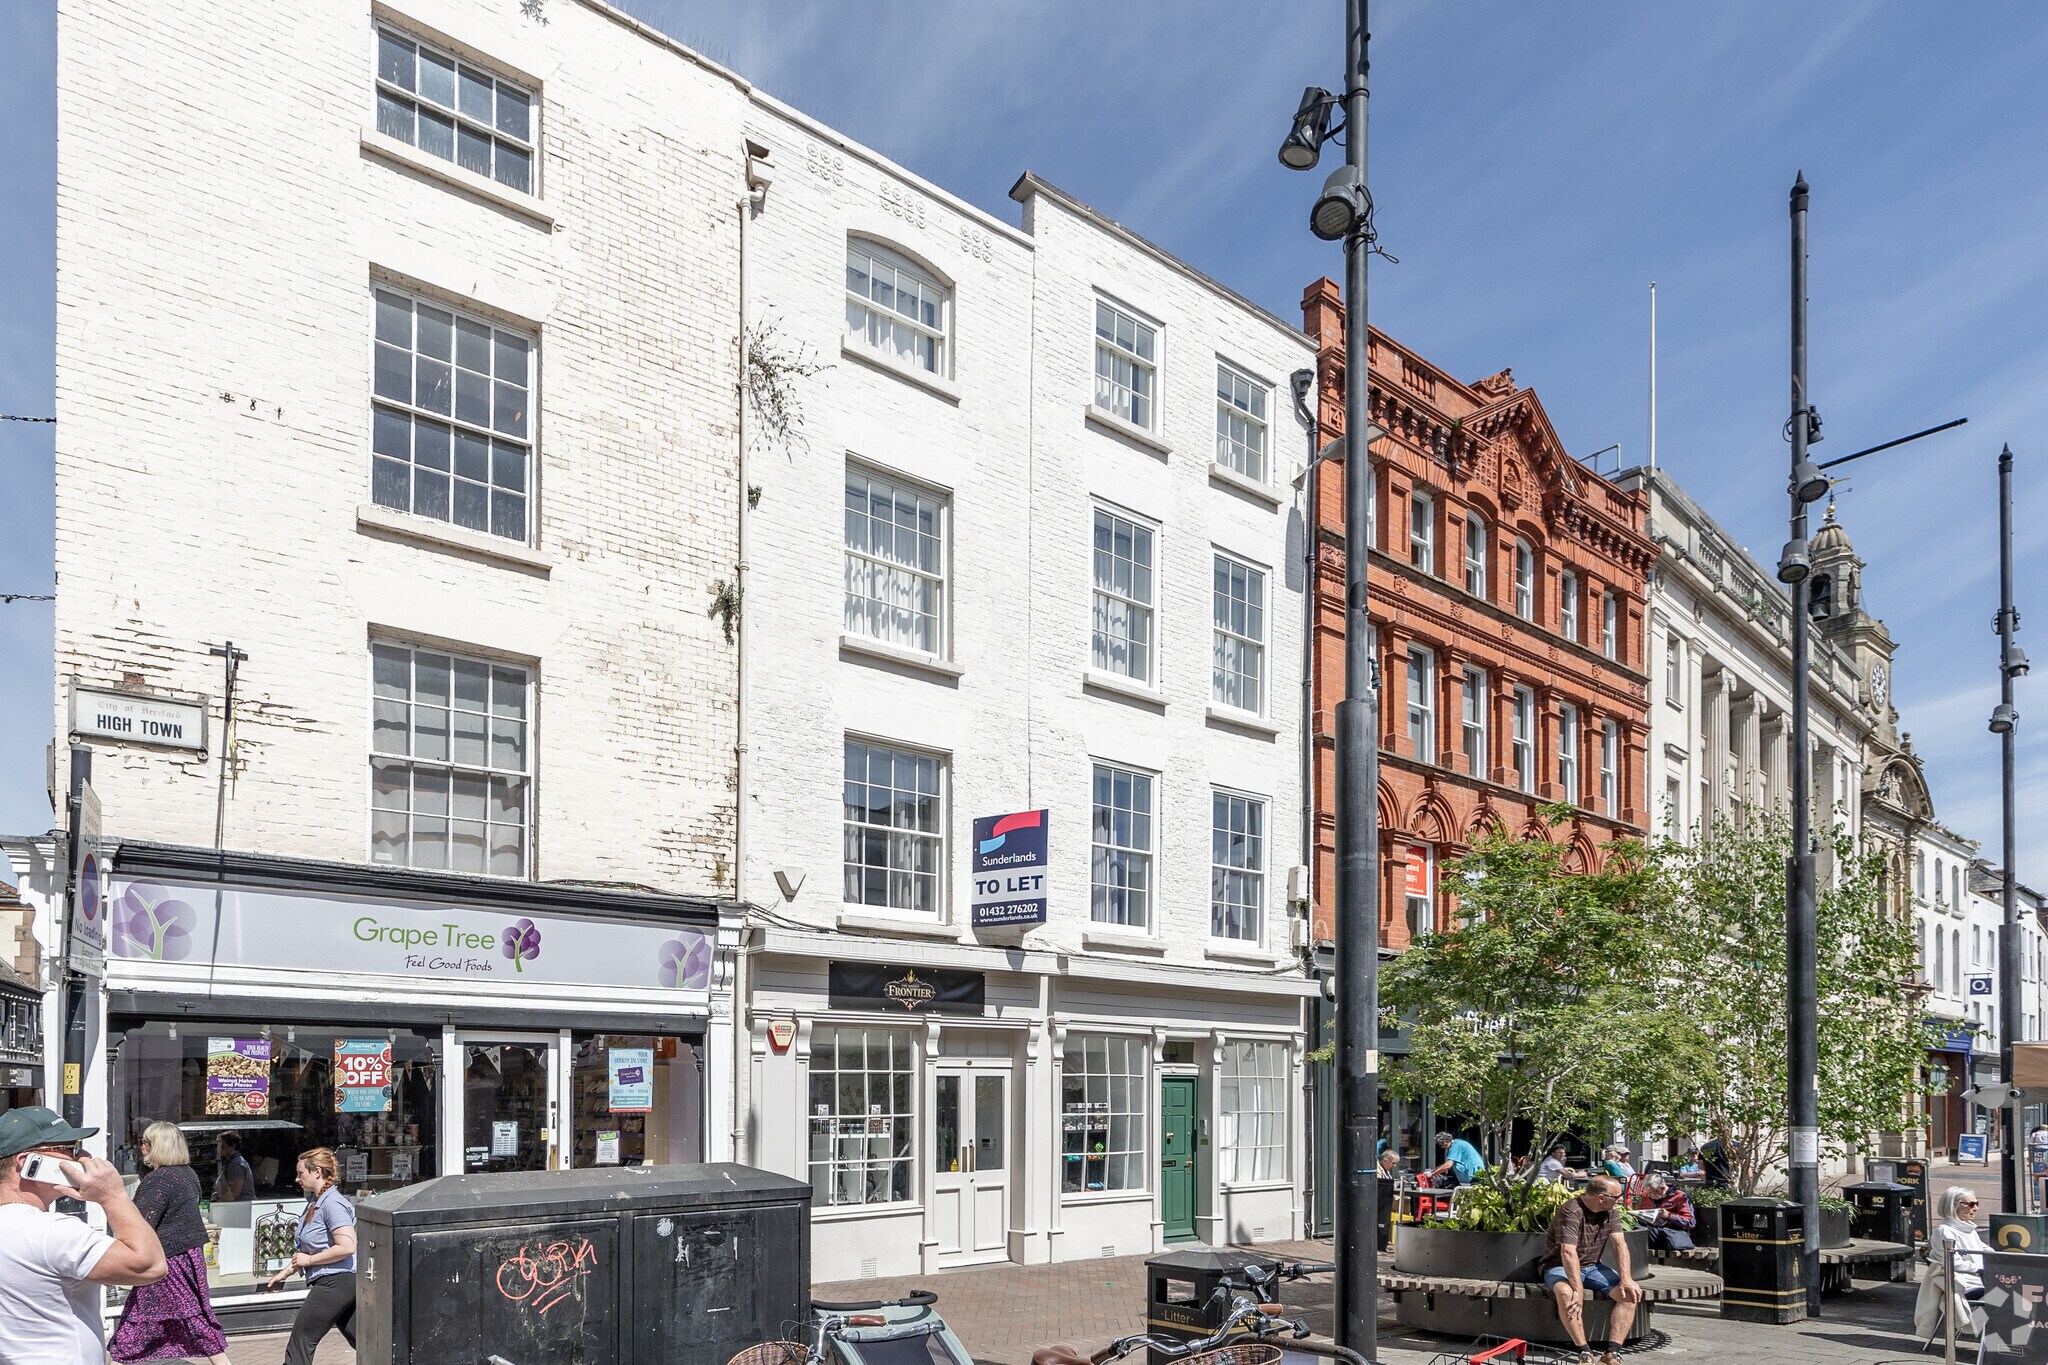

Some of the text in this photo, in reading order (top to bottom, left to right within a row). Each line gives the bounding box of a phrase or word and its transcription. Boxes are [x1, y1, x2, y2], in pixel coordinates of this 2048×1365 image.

[98, 701, 118, 712] City
[141, 708, 181, 719] Hereford
[97, 714, 182, 739] HIGH TOWN
[982, 851, 1037, 866] Sunderlands
[975, 874, 1043, 895] TO LET
[979, 903, 1038, 917] 01432 276202
[980, 913, 1038, 923] www.sunderlands.co.uk
[84, 921, 101, 946] loading
[353, 917, 495, 950] Grape Tree
[404, 955, 493, 972] Feel Good Foods
[889, 985, 931, 998] FRONTIER
[344, 1056, 383, 1071] 10%
[346, 1071, 383, 1085] OFF
[1164, 1310, 1190, 1324] Litter
